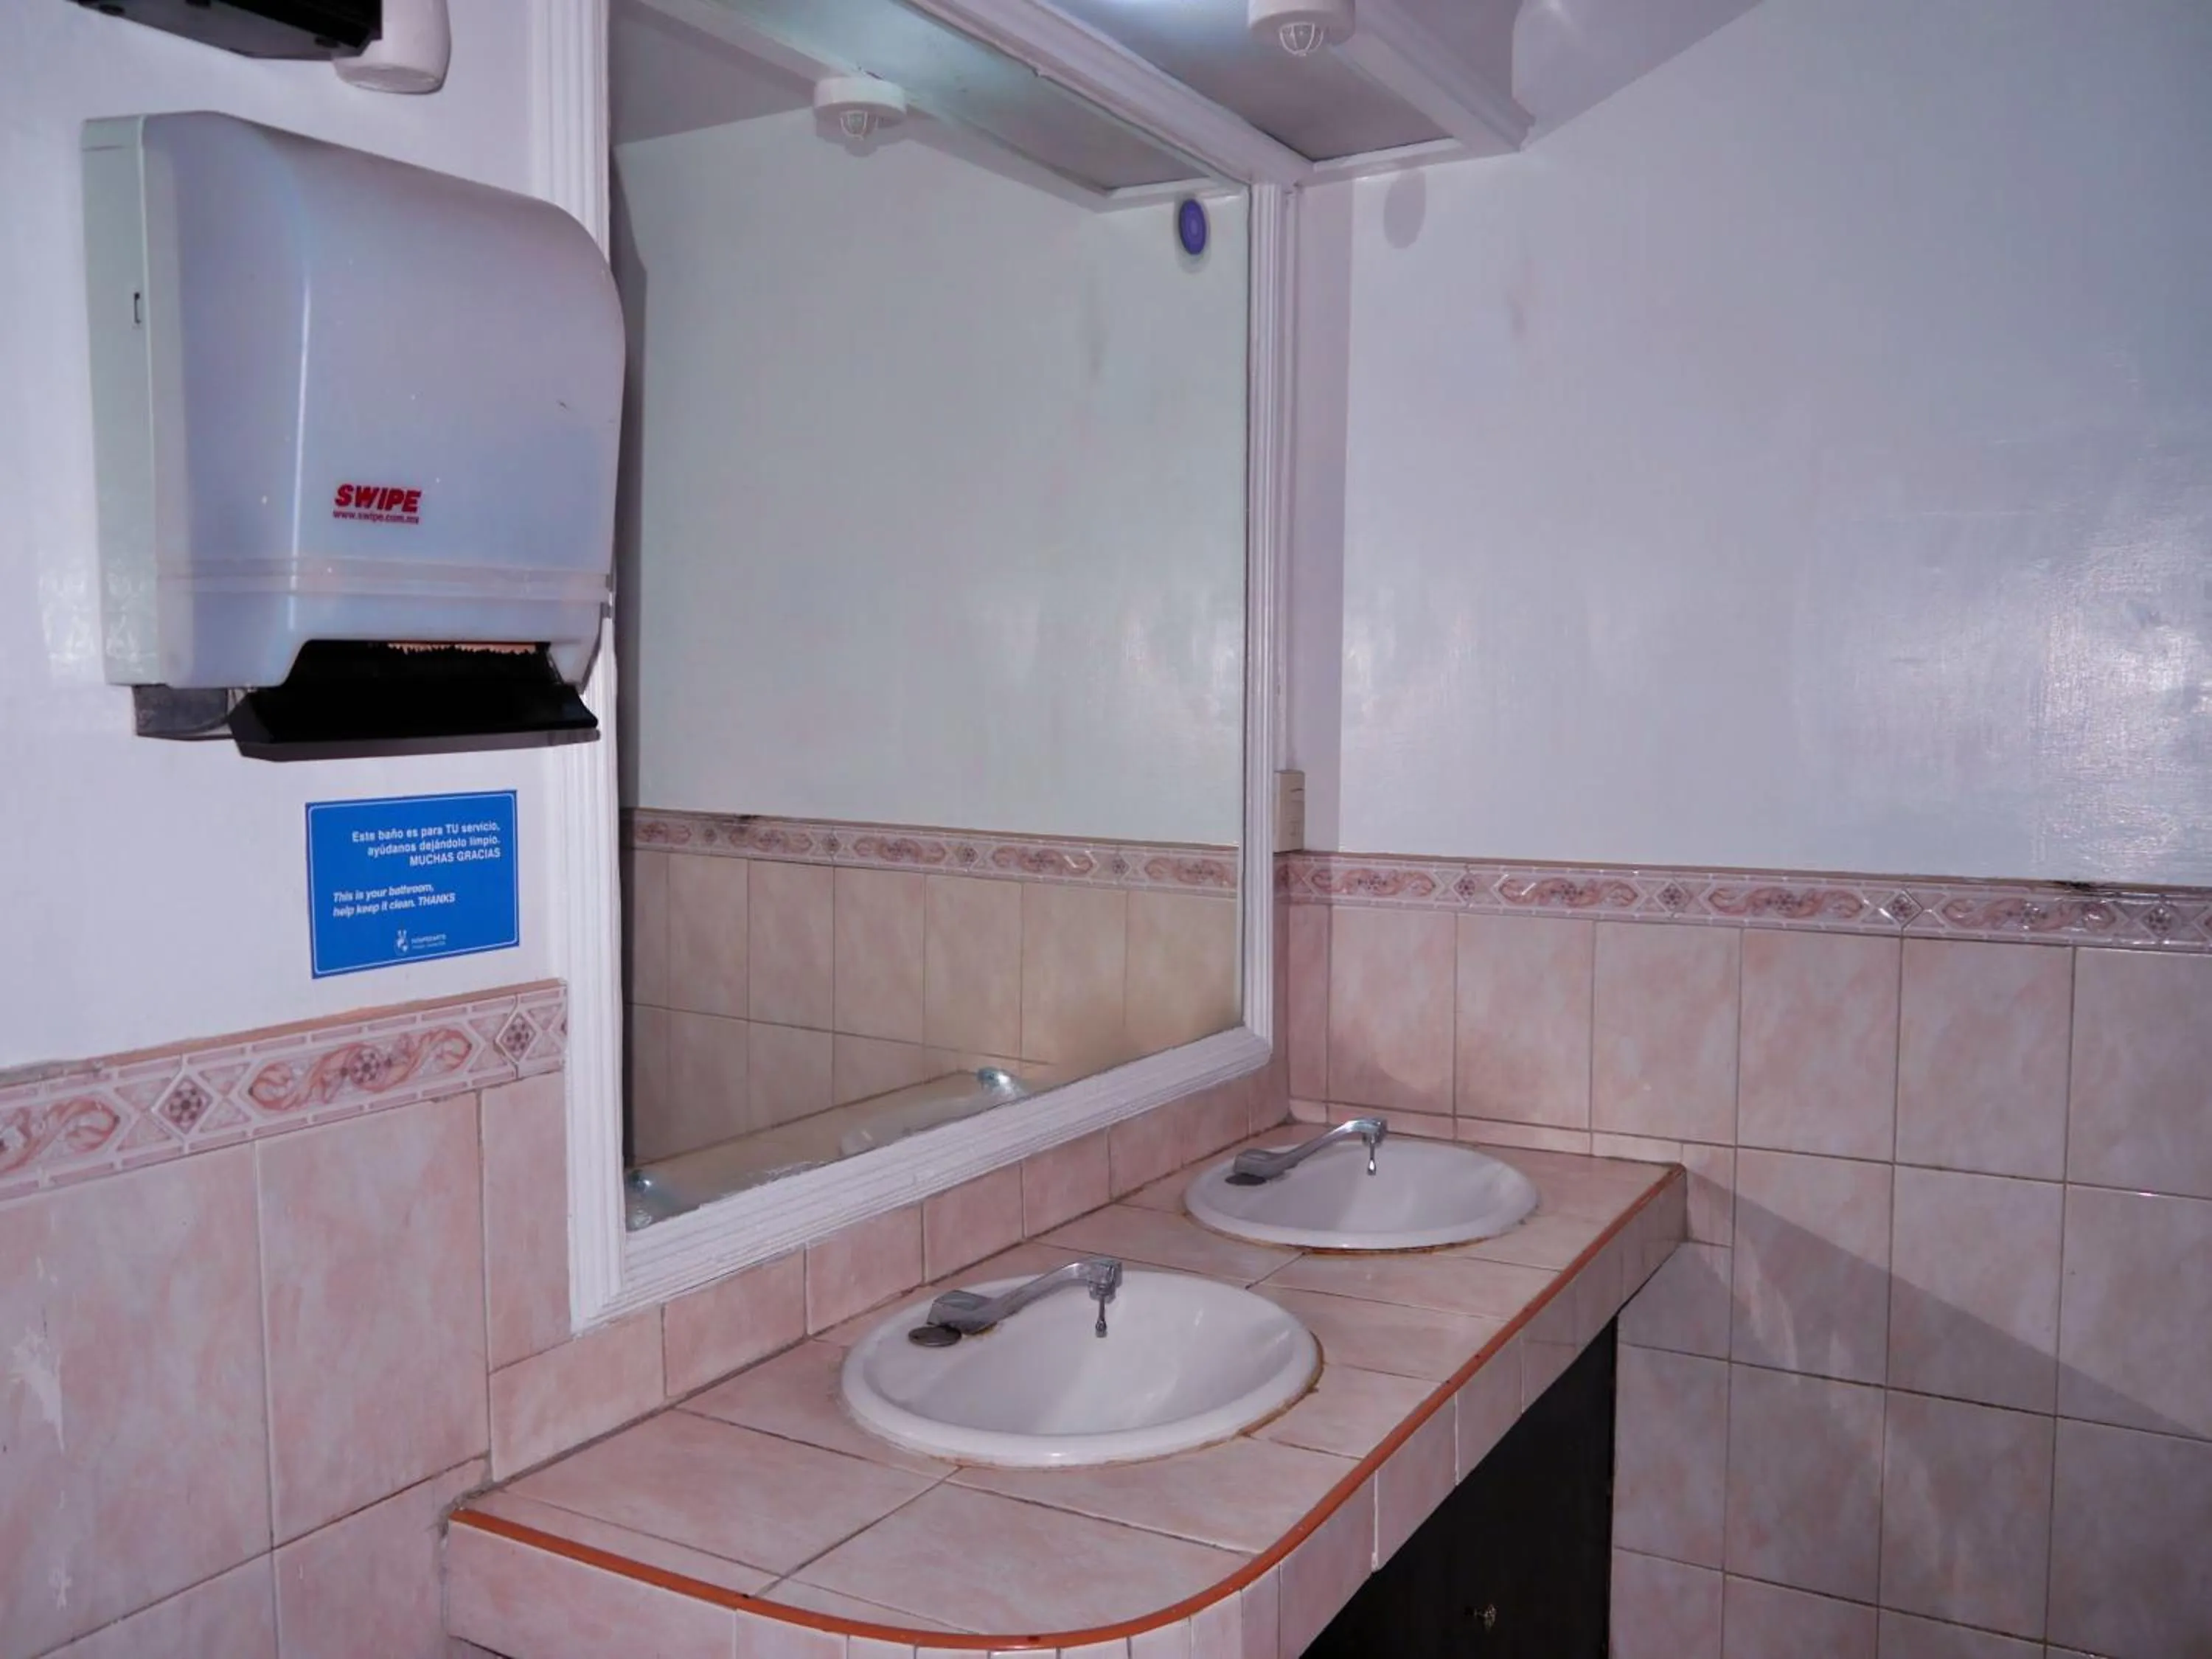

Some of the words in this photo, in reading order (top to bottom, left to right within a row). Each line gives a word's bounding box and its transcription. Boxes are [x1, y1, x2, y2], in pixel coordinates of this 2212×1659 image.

[335, 484, 422, 512] SWIPE
[352, 831, 375, 843] Este
[378, 827, 403, 841] baño
[406, 828, 417, 838] es
[421, 826, 442, 838] para
[445, 823, 459, 834] TU
[367, 842, 417, 858] ayúdanos
[420, 838, 466, 852] dejándolo
[410, 852, 454, 866] MUCHAS
[456, 847, 501, 862] GRACIAS
[333, 891, 353, 902] This
[355, 890, 364, 900] is
[366, 889, 388, 901] your
[333, 906, 355, 918] help
[356, 903, 380, 914] keep
[381, 900, 388, 911] it
[418, 892, 456, 906] THANKS
